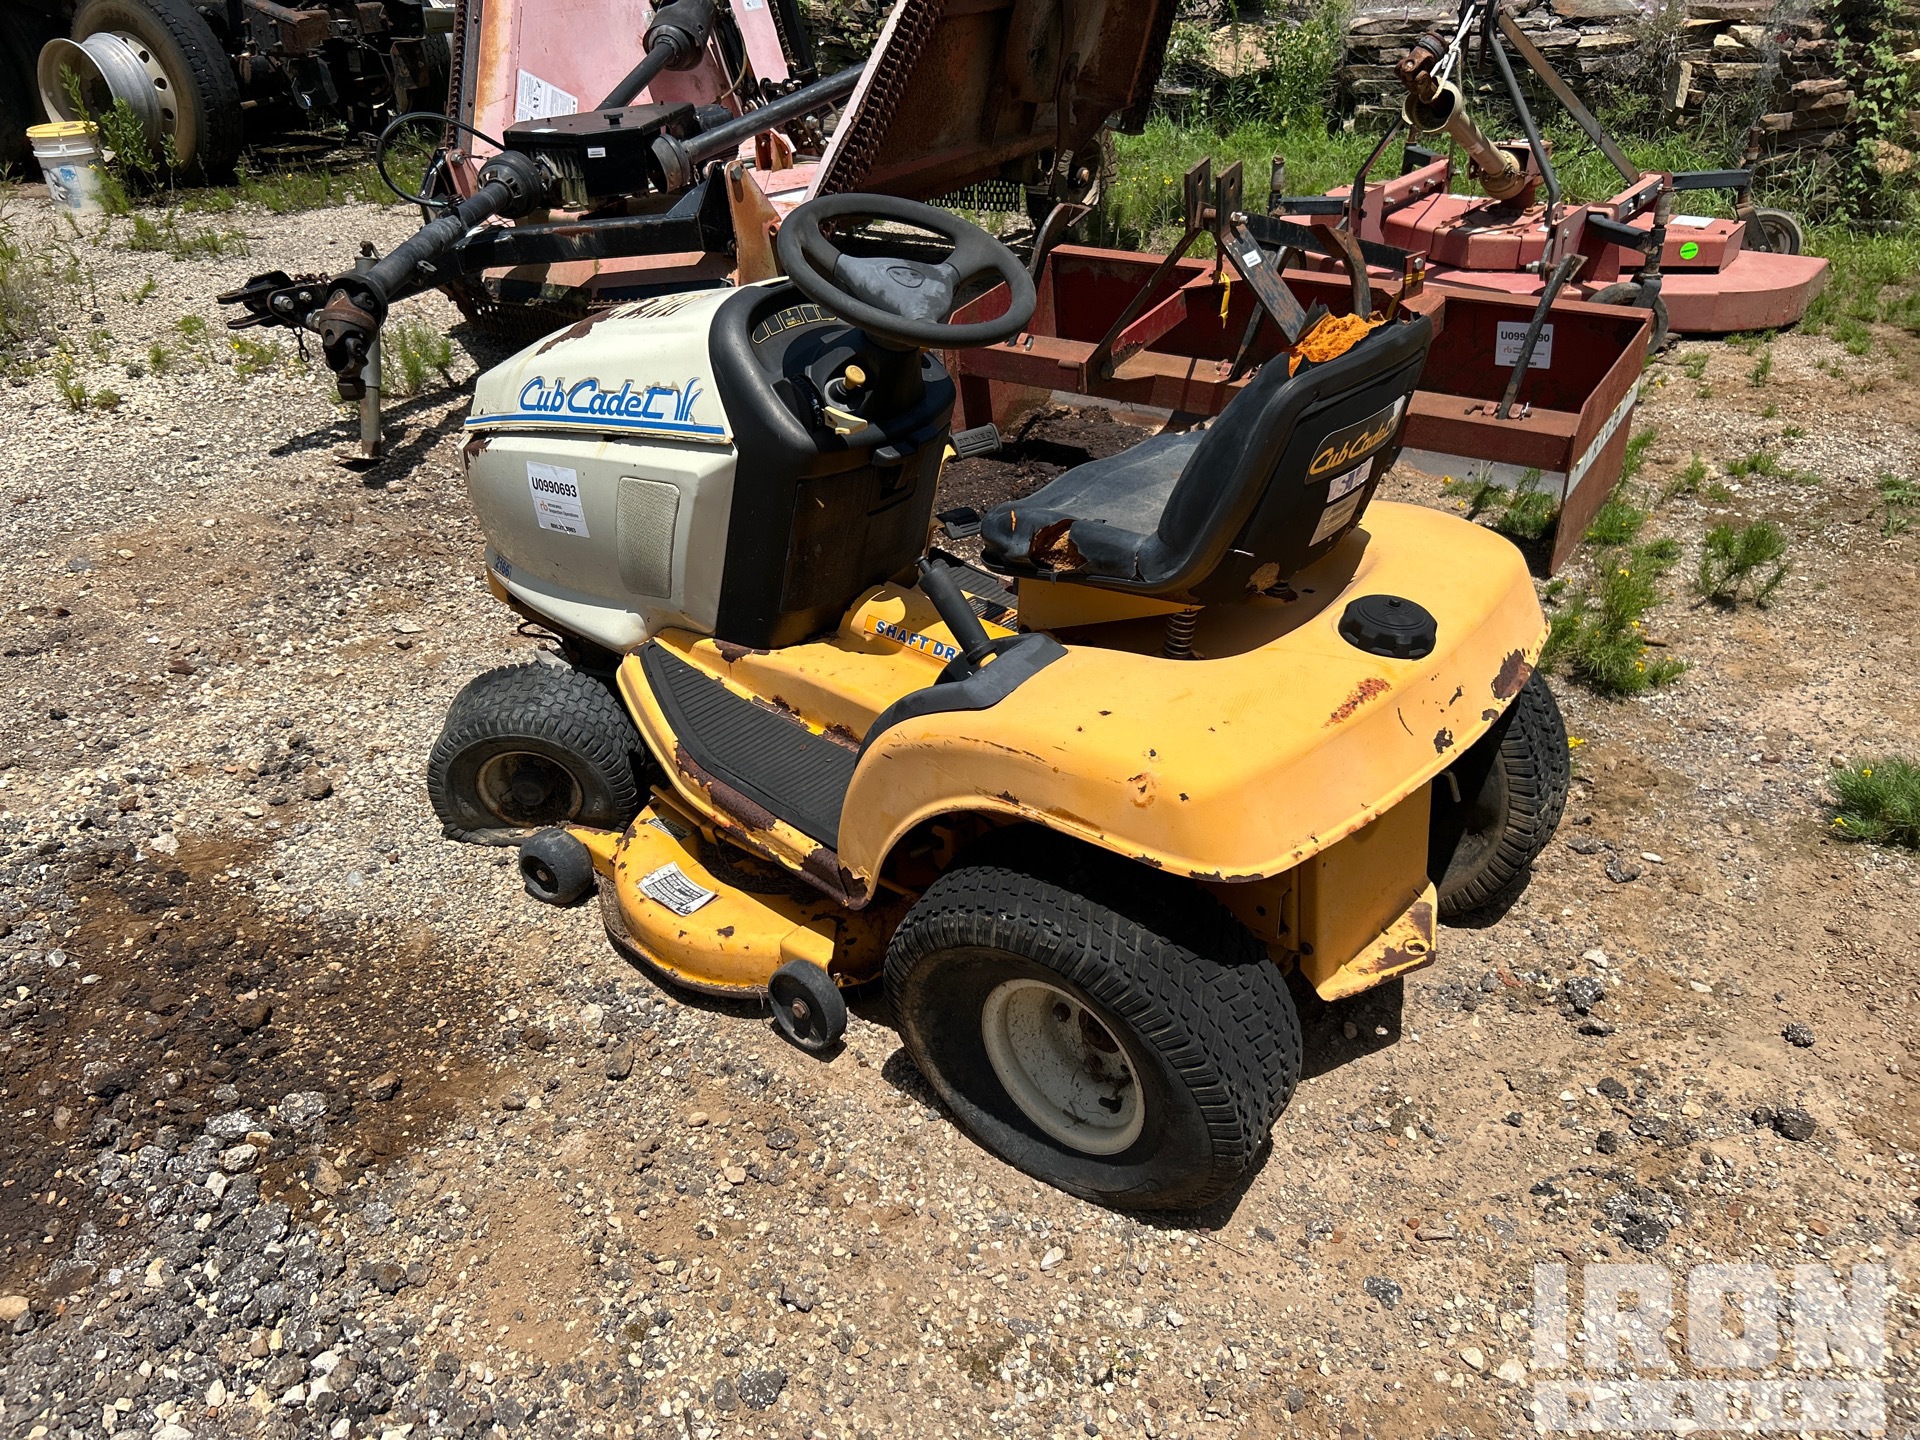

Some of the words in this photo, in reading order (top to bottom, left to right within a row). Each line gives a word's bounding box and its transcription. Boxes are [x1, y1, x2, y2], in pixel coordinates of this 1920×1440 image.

[1501, 331, 1550, 342] U09990
[519, 377, 565, 413] Cub
[567, 379, 673, 420] Cadet
[1310, 441, 1350, 475] Cub
[1349, 416, 1395, 459] Cadet
[532, 476, 577, 498] U0990693
[876, 620, 929, 650] SHAFT
[932, 641, 958, 661] DR
